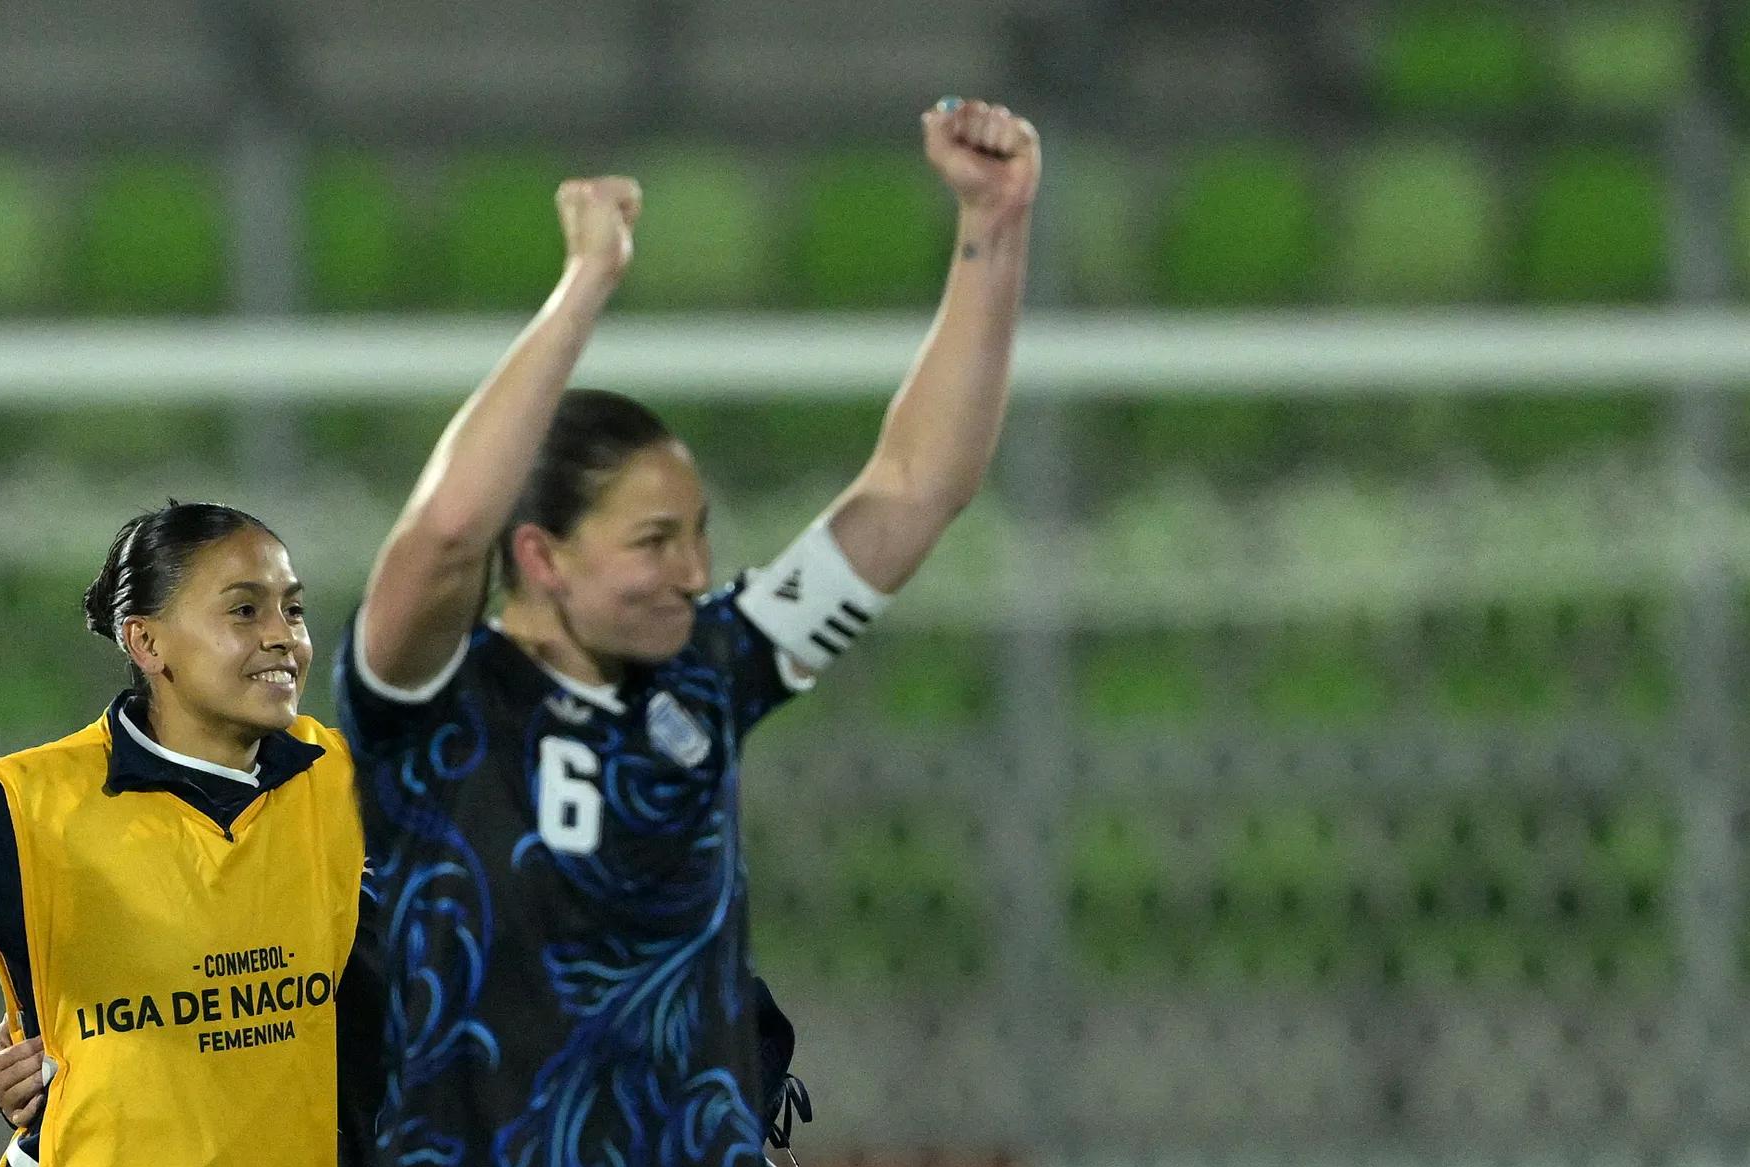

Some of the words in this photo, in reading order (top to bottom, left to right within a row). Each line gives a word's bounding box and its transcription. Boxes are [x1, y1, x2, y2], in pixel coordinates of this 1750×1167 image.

[537, 735, 603, 857] 6
[77, 995, 165, 1040] LIGA
[172, 987, 223, 1026] DE
[230, 970, 337, 1020] NACIO
[198, 1020, 297, 1053] FEMENINA
